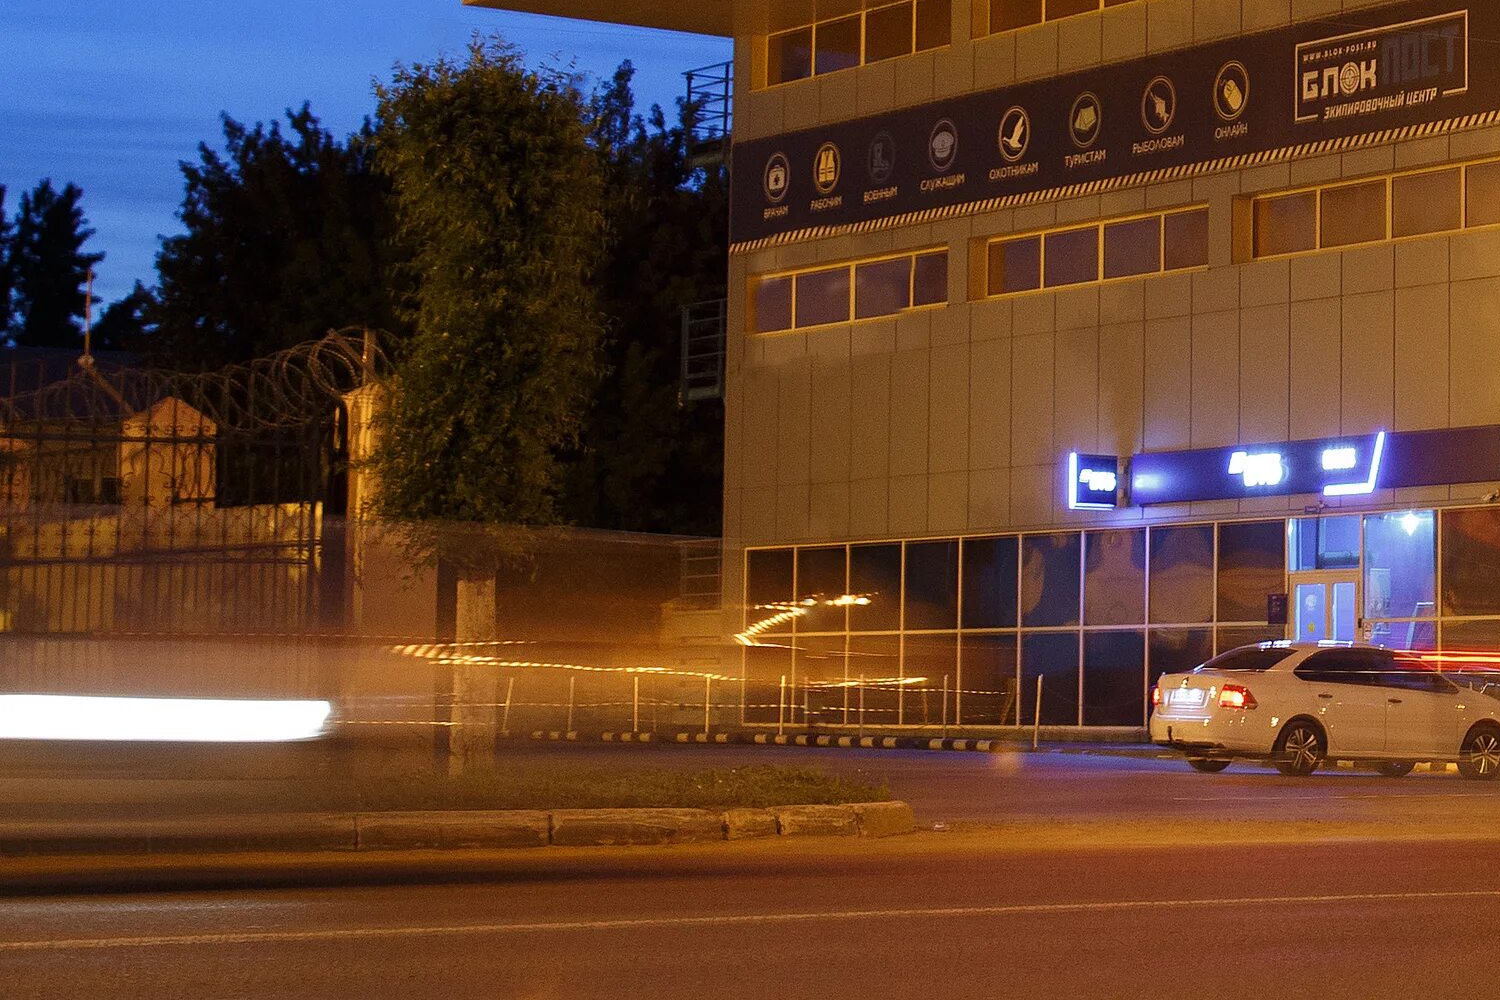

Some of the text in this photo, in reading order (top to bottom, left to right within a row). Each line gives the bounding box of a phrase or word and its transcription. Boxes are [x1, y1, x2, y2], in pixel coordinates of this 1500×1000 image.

[1302, 25, 1461, 101] БЛОК ПОСТ
[1323, 87, 1438, 120] ЭКИПИРОВОЧНЫЙ ЦЕНТР
[1214, 121, 1249, 140] ОНЛАЙН
[1131, 134, 1185, 154] РЫБОЛОВАМ
[1064, 149, 1107, 168] ТУРИСТАМ
[988, 161, 1039, 181] ОХОТНИКАМ
[919, 173, 966, 192] СЛУЖАЩИМ
[809, 196, 843, 212] РАБОЧИМ
[863, 186, 899, 203] ВОЕННЫМ
[763, 205, 789, 220] ВРАЧАМ
